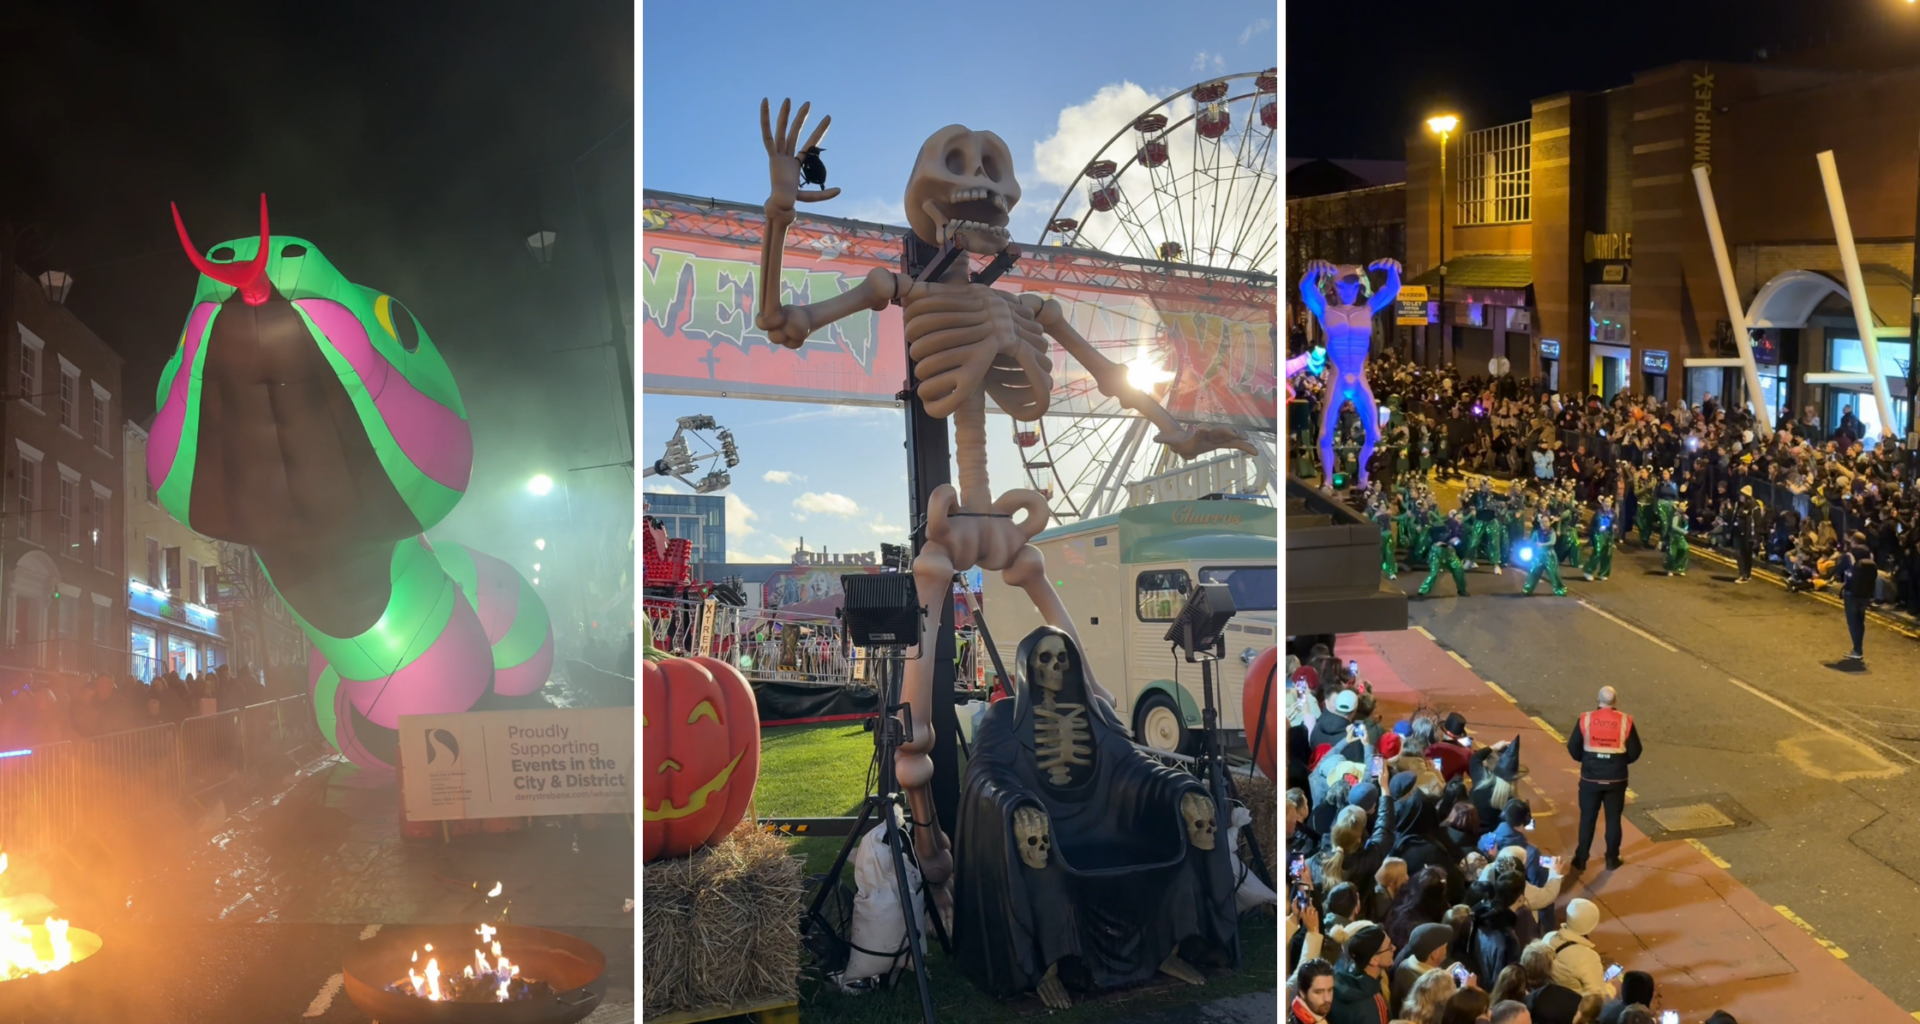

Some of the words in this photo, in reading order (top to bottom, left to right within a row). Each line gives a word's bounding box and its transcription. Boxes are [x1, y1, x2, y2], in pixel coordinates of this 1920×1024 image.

[1172, 505, 1242, 525] Churros
[793, 551, 876, 565] CULLENS
[508, 724, 569, 740] Proudly
[510, 740, 600, 757] Supporting
[511, 758, 567, 772] Events
[570, 757, 585, 771] in
[588, 756, 616, 770] the
[513, 775, 546, 792] City
[550, 774, 562, 788] &
[565, 774, 626, 788] District
[515, 790, 628, 802] derrystrabane.com/whatson
